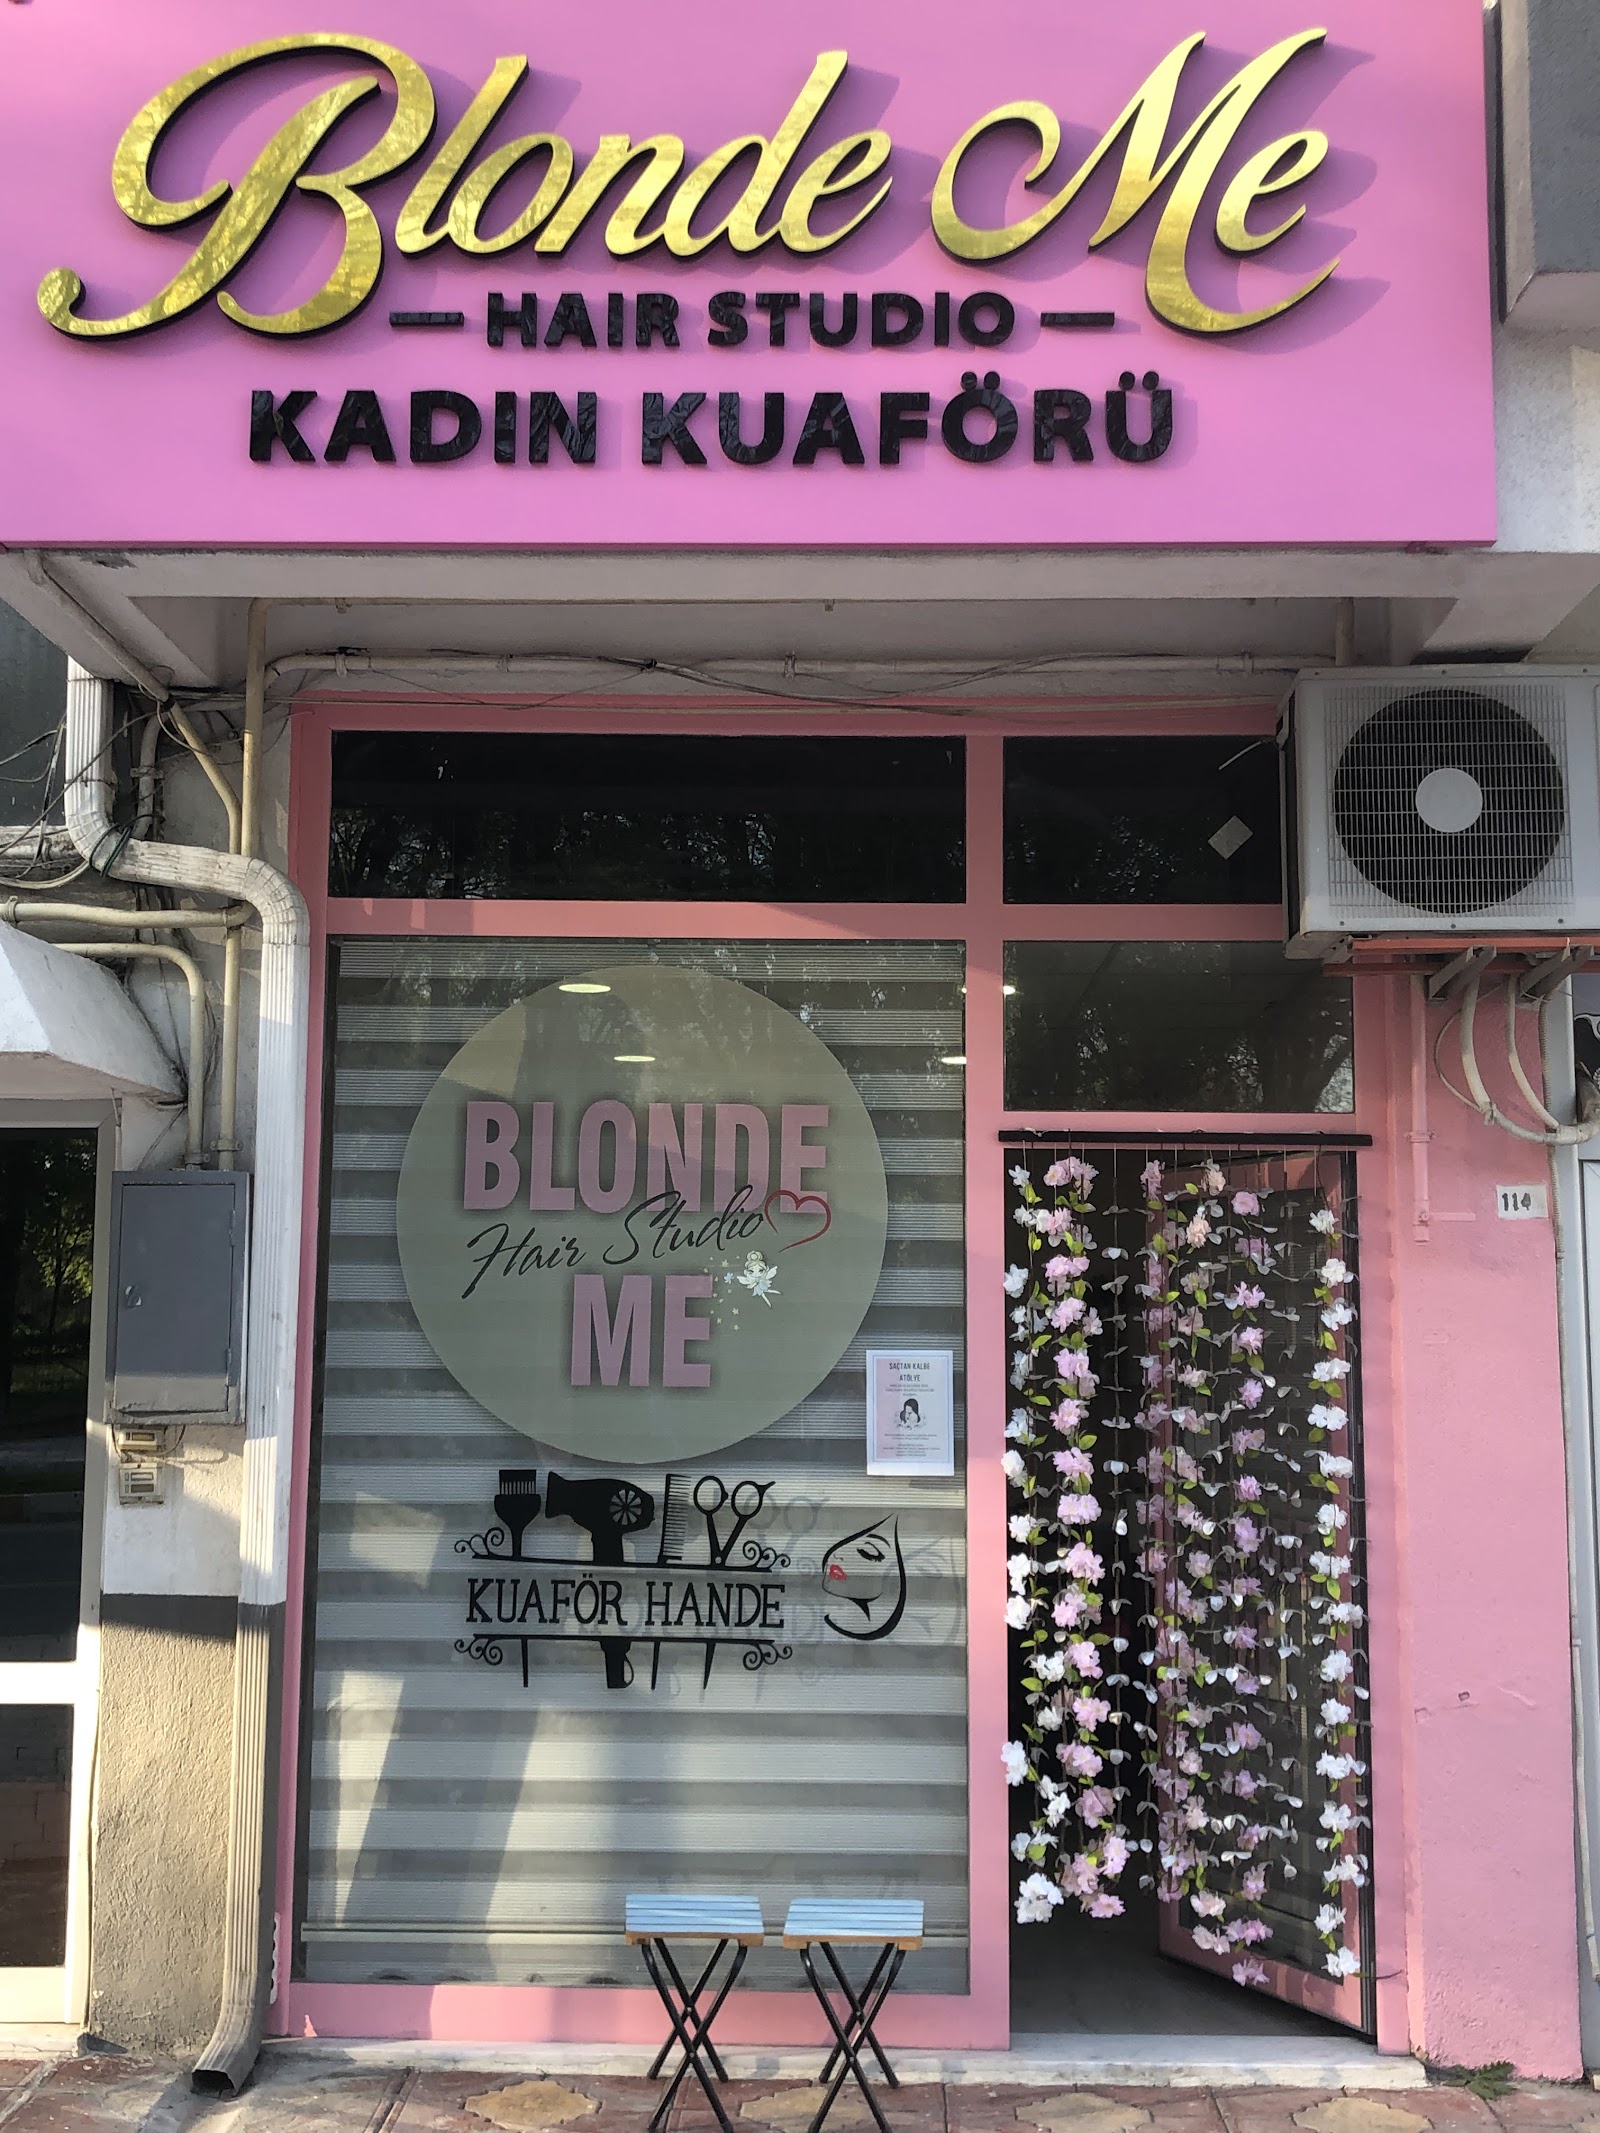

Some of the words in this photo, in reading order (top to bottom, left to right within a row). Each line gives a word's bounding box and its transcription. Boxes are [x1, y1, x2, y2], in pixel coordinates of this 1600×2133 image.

[37, 31, 894, 341] Blonde
[930, 26, 1341, 337] Me
[486, 291, 680, 348] HAIR
[708, 290, 1015, 348] STUDIO
[248, 389, 599, 465] KADIN
[641, 371, 1174, 465] KUAFÖRÜ
[463, 1099, 830, 1214] BLONDE
[461, 1222, 589, 1300] Hair
[602, 1184, 766, 1266] Studio
[570, 1273, 714, 1389] ME
[465, 1573, 628, 1627] KUAFÖR
[645, 1581, 786, 1629] HANDE
